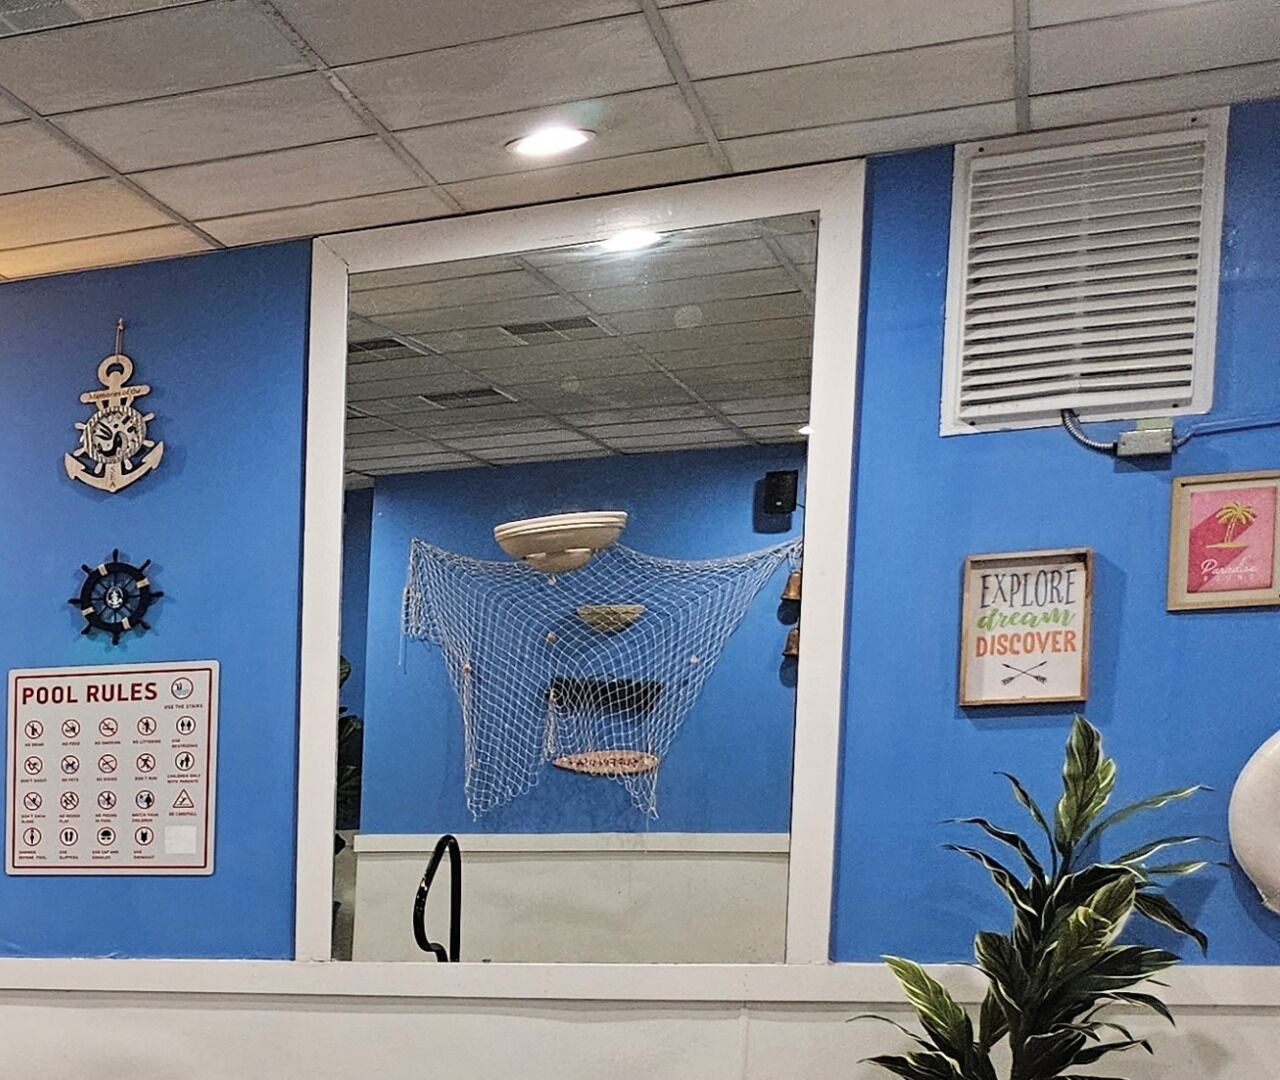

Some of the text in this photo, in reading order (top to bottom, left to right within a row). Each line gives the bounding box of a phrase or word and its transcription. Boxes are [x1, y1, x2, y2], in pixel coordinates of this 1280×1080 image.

[980, 568, 1077, 609] EXPLORE
[977, 607, 1076, 631] dream
[975, 630, 1077, 657] DISCOVER
[22, 682, 158, 705] POOL RULES
